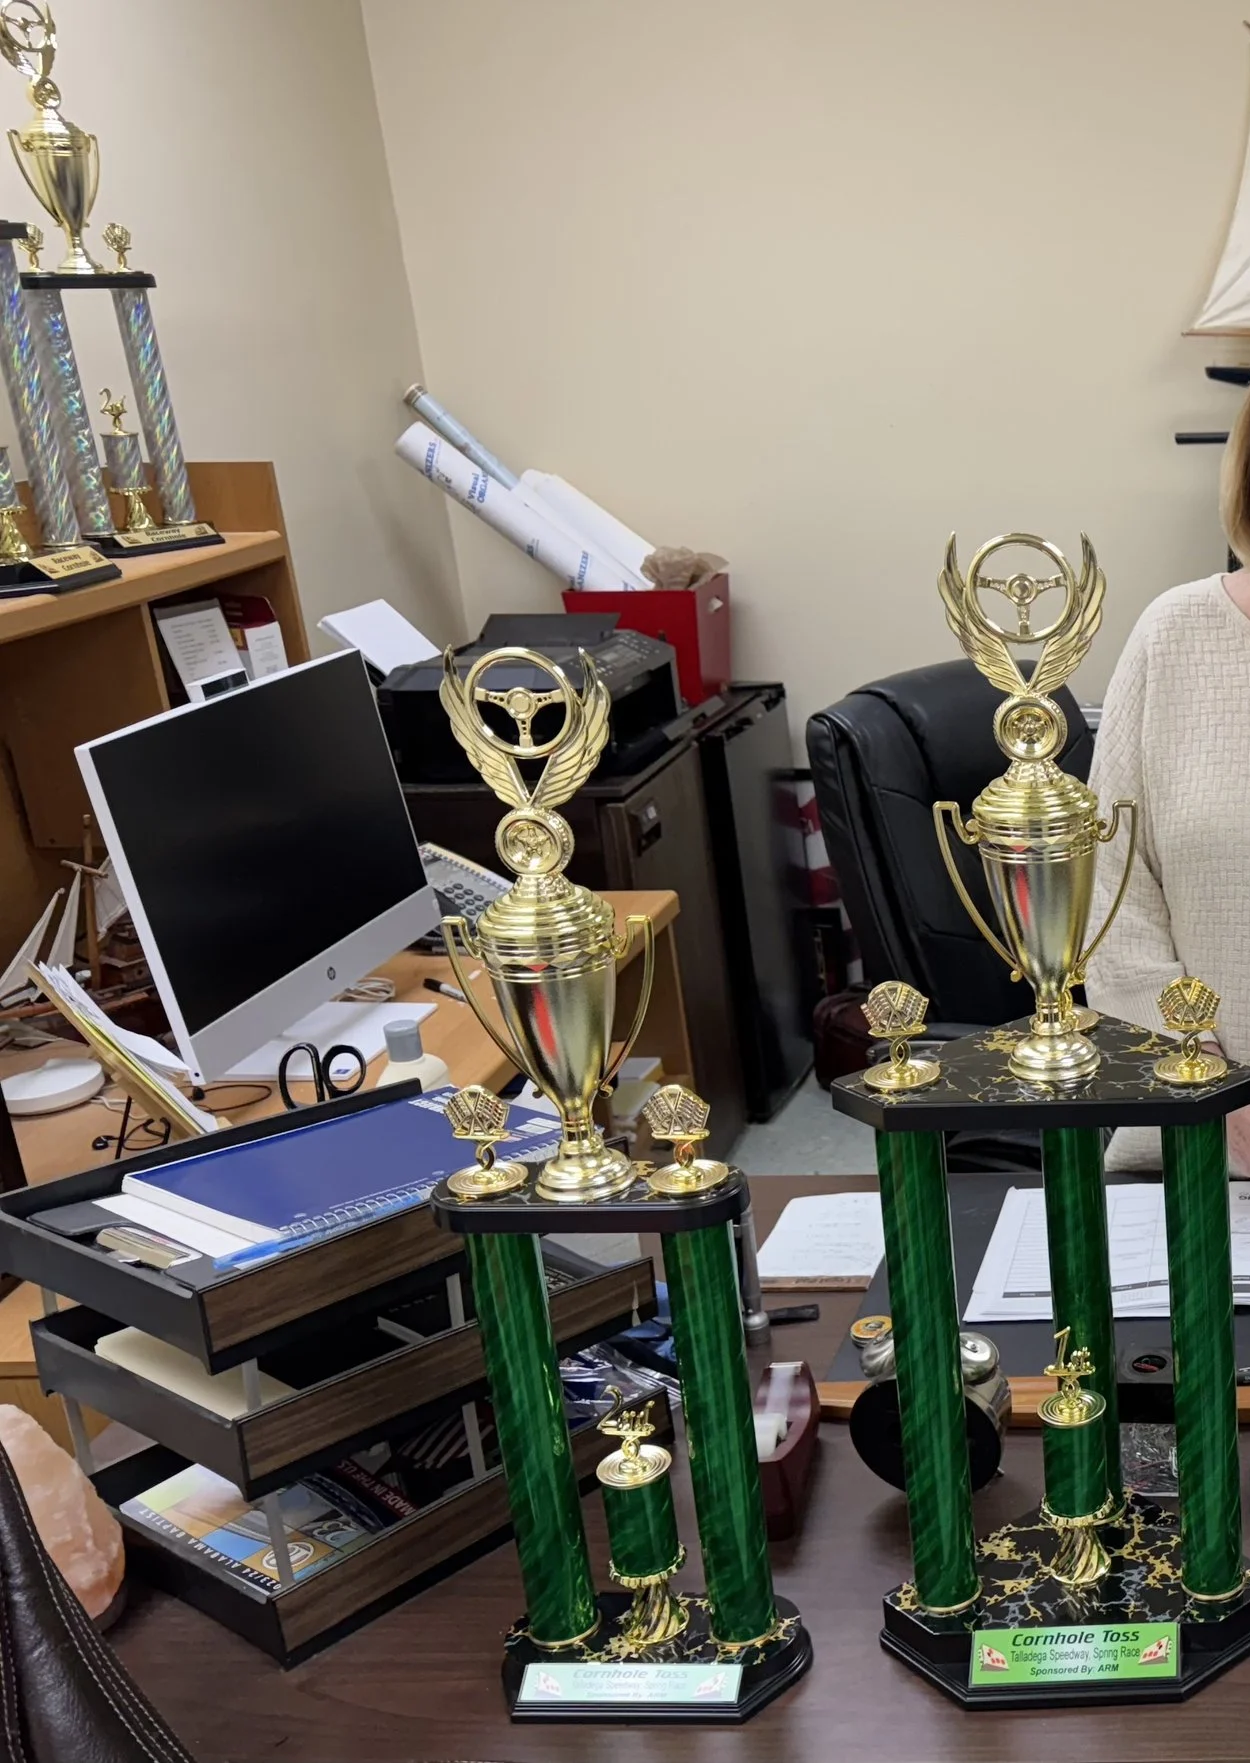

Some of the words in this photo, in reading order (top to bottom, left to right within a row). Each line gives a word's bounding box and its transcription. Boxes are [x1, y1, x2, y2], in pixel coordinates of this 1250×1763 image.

[382, 1491, 416, 1516] MADE
[139, 1509, 186, 1538] BAPTIST
[188, 1538, 241, 1569] ALABAMA
[241, 1567, 282, 1590] 023/24
[1012, 1631, 1095, 1647] Cornhole
[1103, 1630, 1140, 1643] Toss
[1011, 1649, 1047, 1664] Talladega
[1093, 1647, 1118, 1661] Spring
[1120, 1646, 1141, 1657] Race
[572, 1668, 649, 1679] Cornhole
[654, 1669, 688, 1679] Toss
[1030, 1665, 1078, 1676] Sponsored
[1081, 1665, 1095, 1675] By:
[1098, 1664, 1119, 1672] ARM
